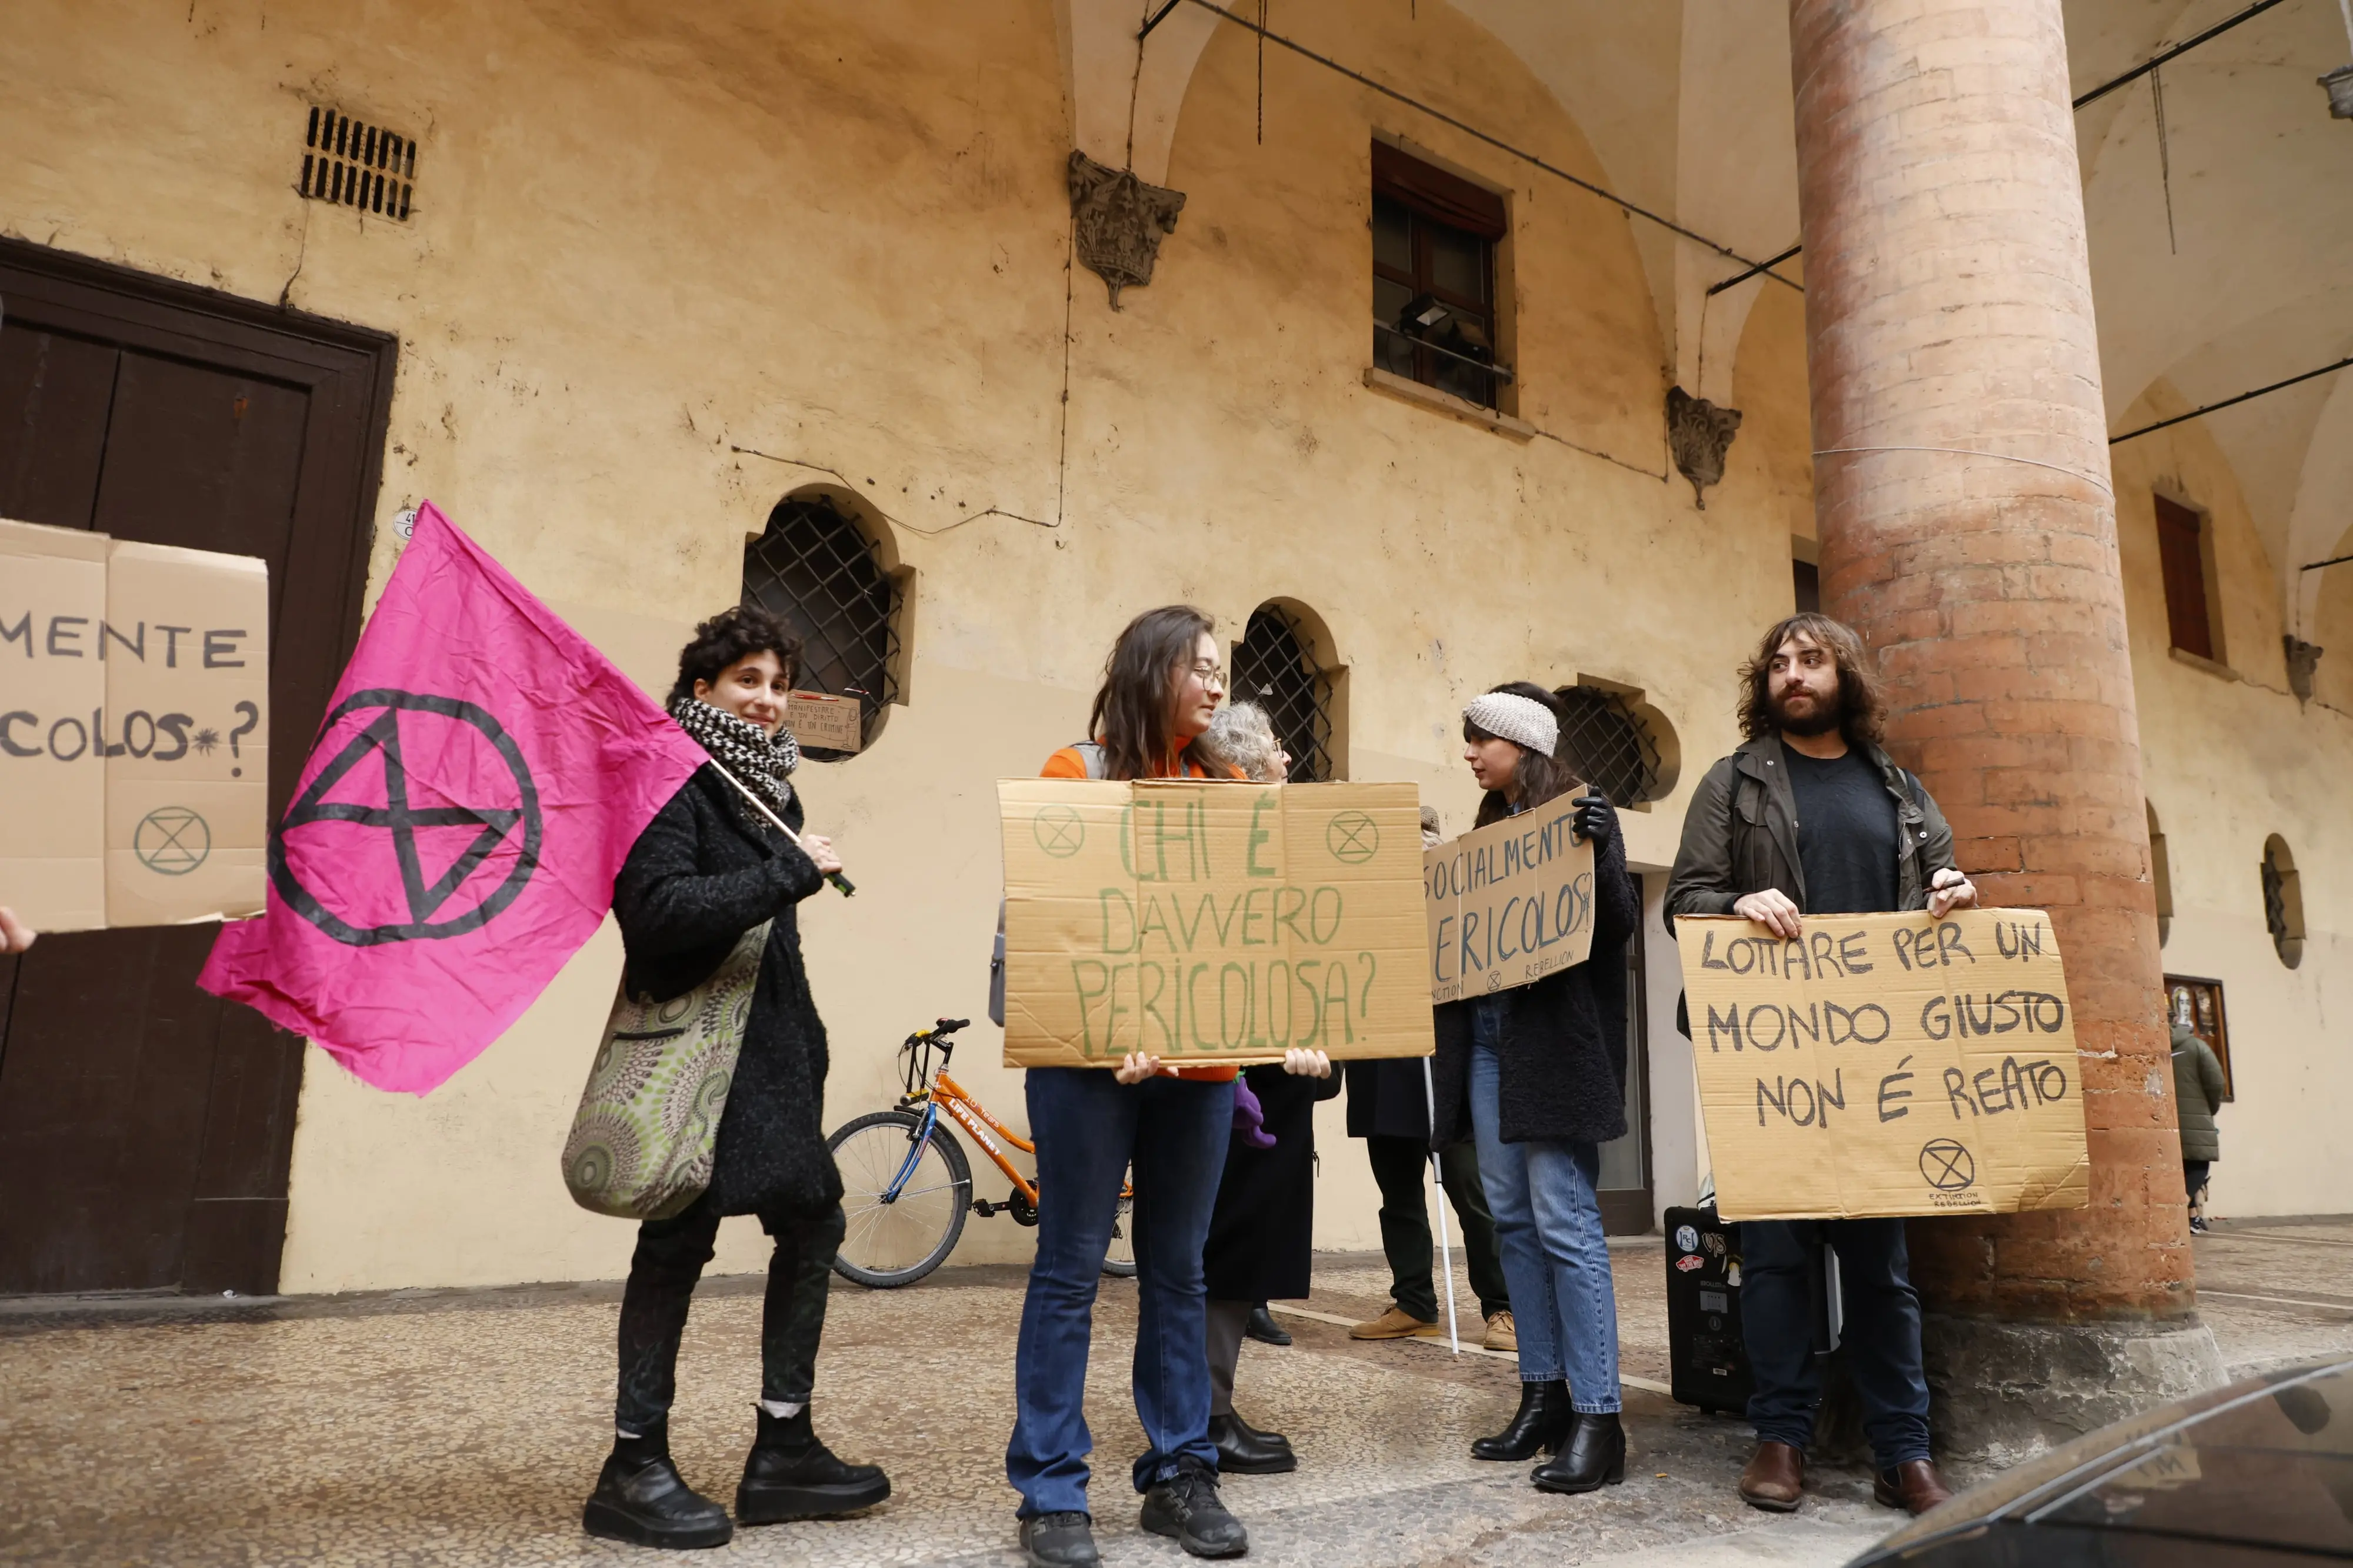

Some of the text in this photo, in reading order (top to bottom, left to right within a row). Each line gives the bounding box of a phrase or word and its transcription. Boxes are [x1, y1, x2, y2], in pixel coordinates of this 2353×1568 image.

[0, 610, 247, 669] MENTE
[782, 720, 795, 728] NON
[807, 721, 816, 730] UN
[820, 722, 843, 735] CRIMINE
[788, 704, 835, 715] MANIFESTARE
[814, 713, 838, 722] DIRITTO
[1120, 788, 1211, 882] CHI
[1526, 950, 1574, 979] REBELLION
[1701, 921, 2041, 980] LOTTARE PER UN
[1071, 952, 1376, 1056] PERICOLOSA?
[1708, 990, 2064, 1053] MONDO GIUSTO
[981, 1107, 1000, 1128] Years
[1757, 1067, 1846, 1129] NON
[1943, 1056, 2067, 1119] REATO
[948, 1097, 1001, 1156] LIFE PLANET
[1934, 1199, 1981, 1207] REBELLION
